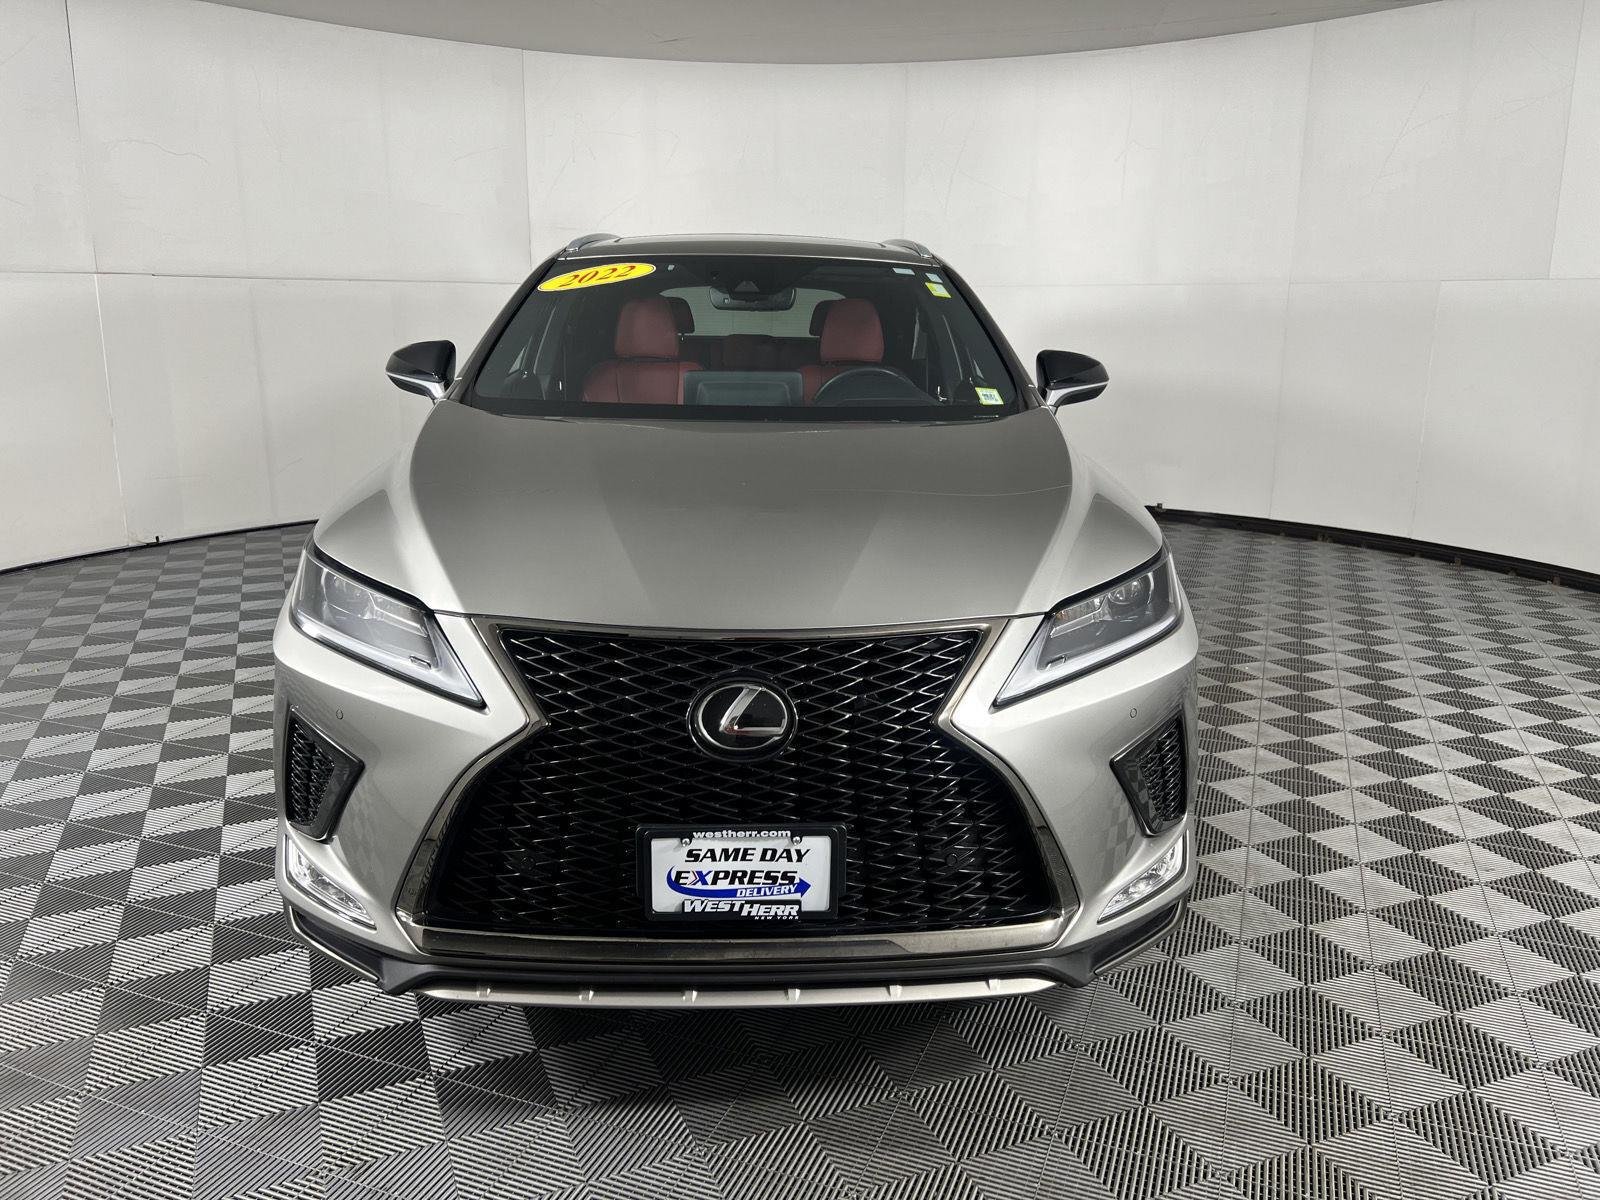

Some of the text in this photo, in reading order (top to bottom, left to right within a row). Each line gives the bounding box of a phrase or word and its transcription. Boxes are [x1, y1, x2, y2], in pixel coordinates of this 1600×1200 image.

[558, 265, 636, 288] 2022
[692, 830, 791, 839] westherr.com
[685, 848, 810, 863] SAME DAY
[674, 870, 798, 885] EXPRESS
[736, 884, 798, 898] DELIVERY
